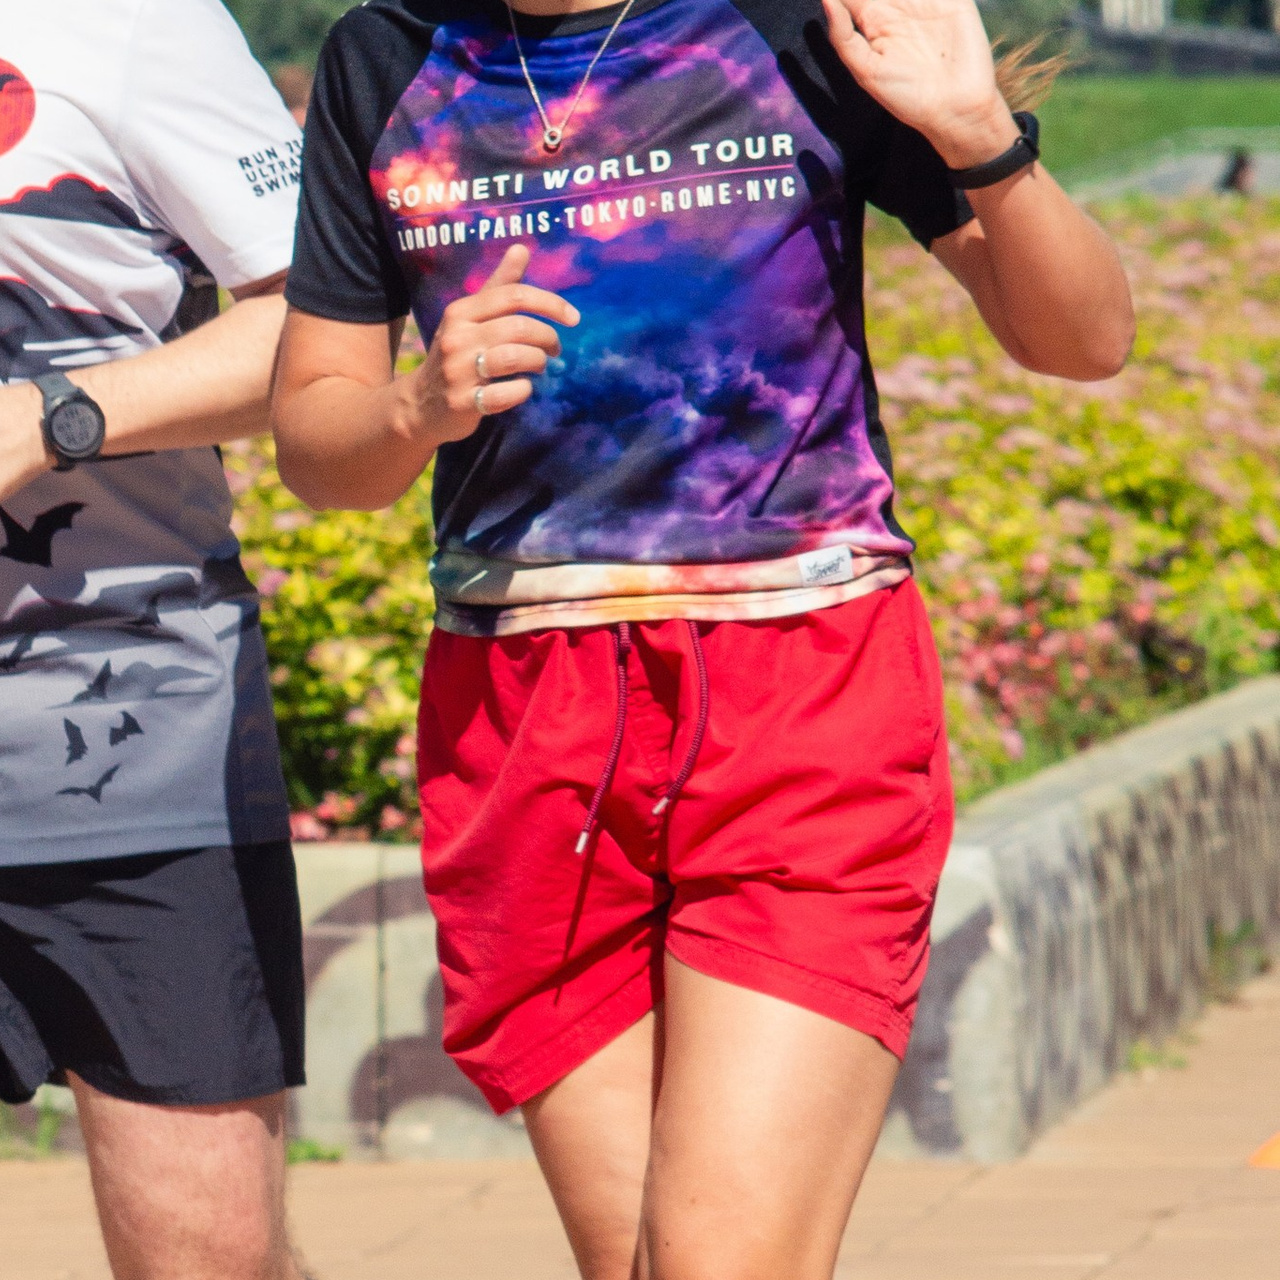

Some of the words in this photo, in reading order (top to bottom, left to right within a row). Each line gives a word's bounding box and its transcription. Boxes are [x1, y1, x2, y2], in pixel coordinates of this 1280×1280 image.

[238, 146, 278, 170] RUN
[386, 173, 524, 210] SONNETI
[542, 149, 672, 190] WORLD
[690, 133, 794, 165] TOUR
